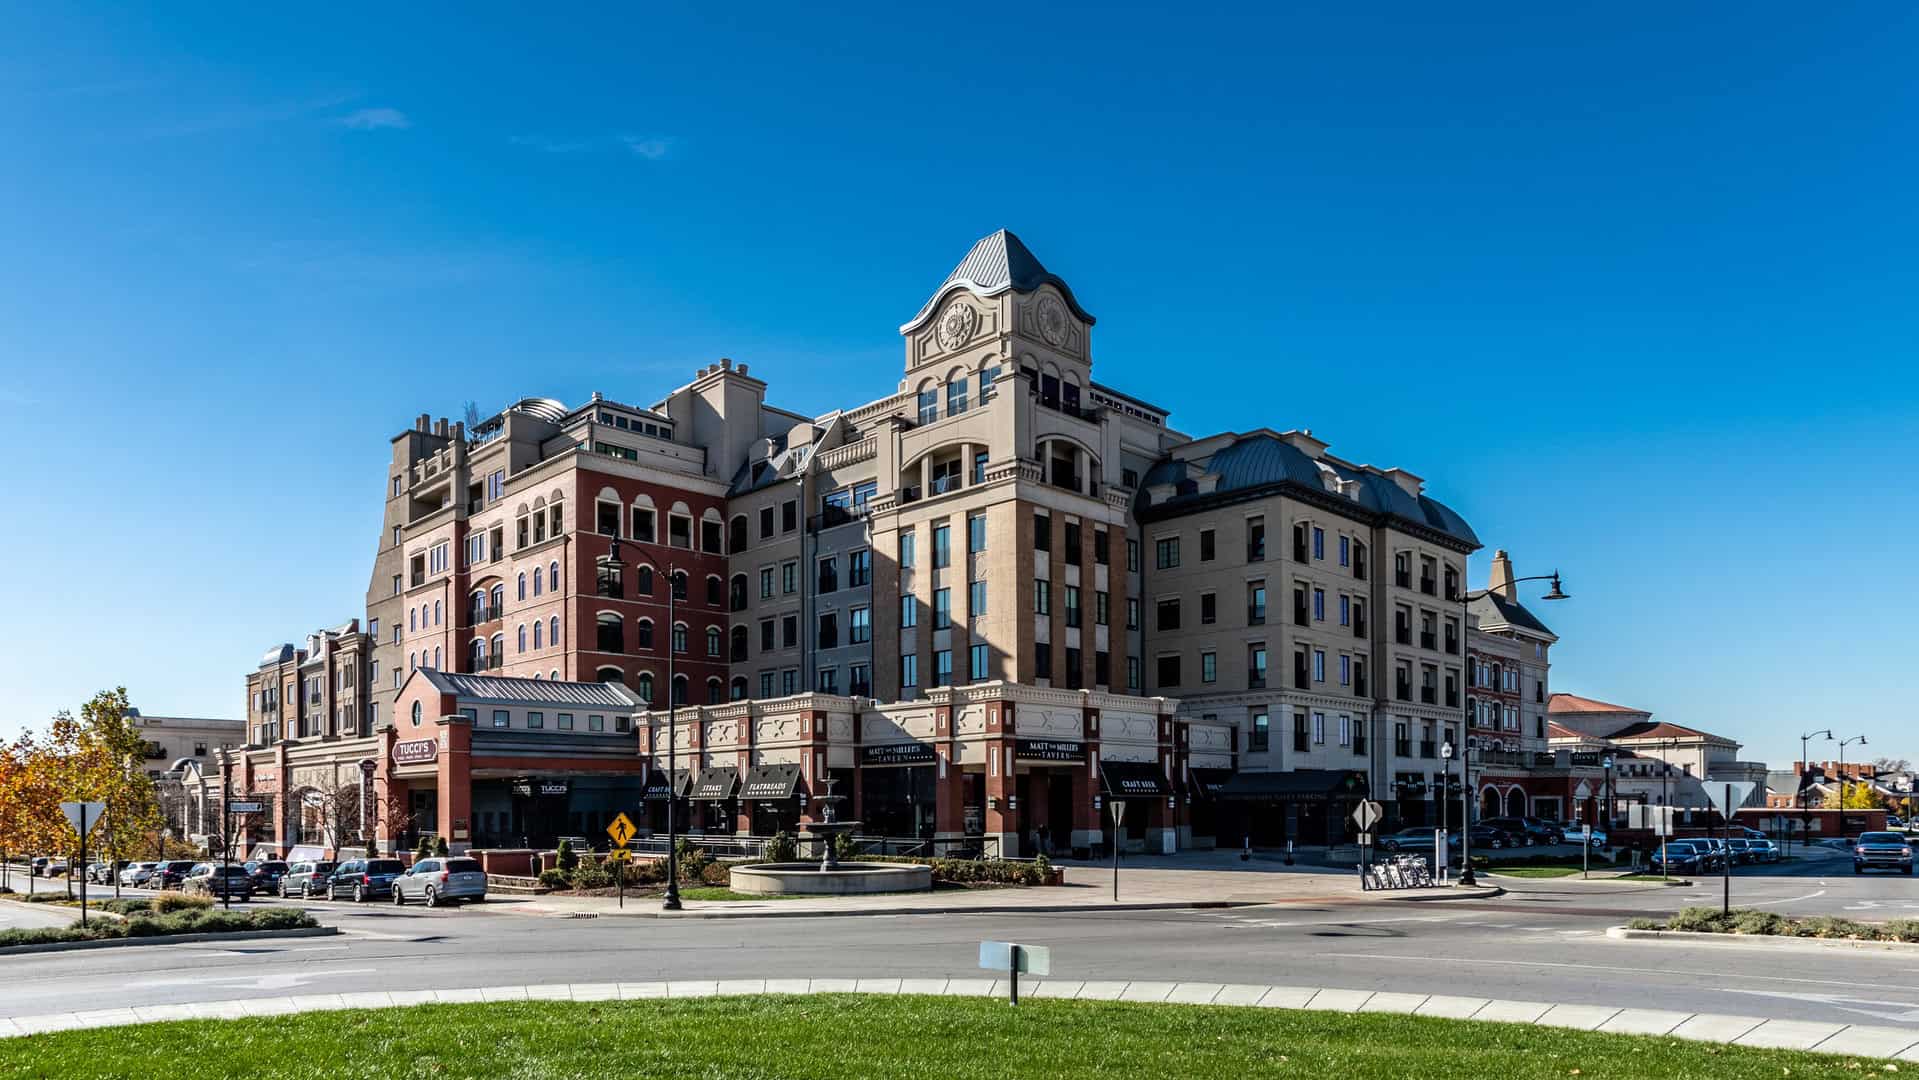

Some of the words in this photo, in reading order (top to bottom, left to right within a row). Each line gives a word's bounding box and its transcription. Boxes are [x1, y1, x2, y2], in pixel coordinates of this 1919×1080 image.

[400, 741, 429, 755] TUCCI'S
[1029, 742, 1049, 751] MATT
[1042, 751, 1070, 760] TAVERN
[702, 784, 722, 793] STEAKS
[749, 782, 787, 791] FLATBREADS
